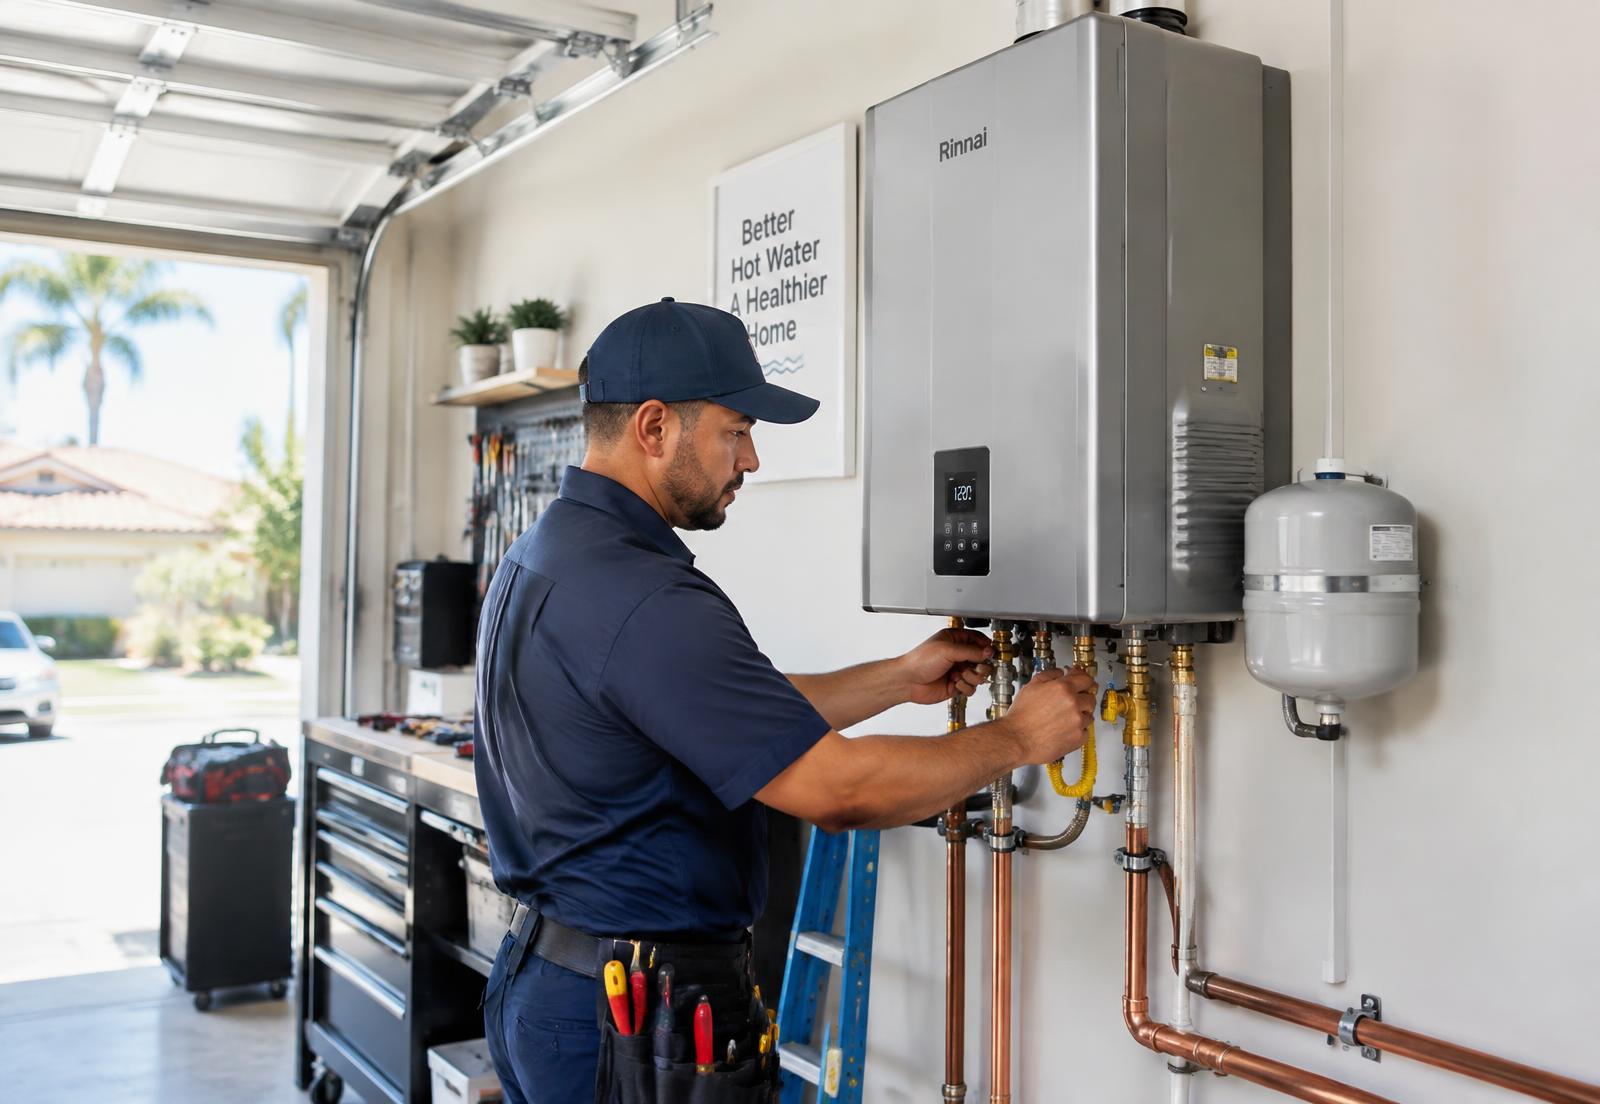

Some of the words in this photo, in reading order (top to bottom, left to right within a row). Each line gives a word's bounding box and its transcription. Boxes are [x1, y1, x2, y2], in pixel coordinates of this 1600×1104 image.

[939, 127, 988, 162] Rinnai
[742, 209, 795, 246] Better
[731, 253, 761, 284] Hot
[766, 239, 820, 273] Water
[730, 292, 742, 317] A
[746, 274, 827, 315] Healthier
[747, 319, 797, 347] Home
